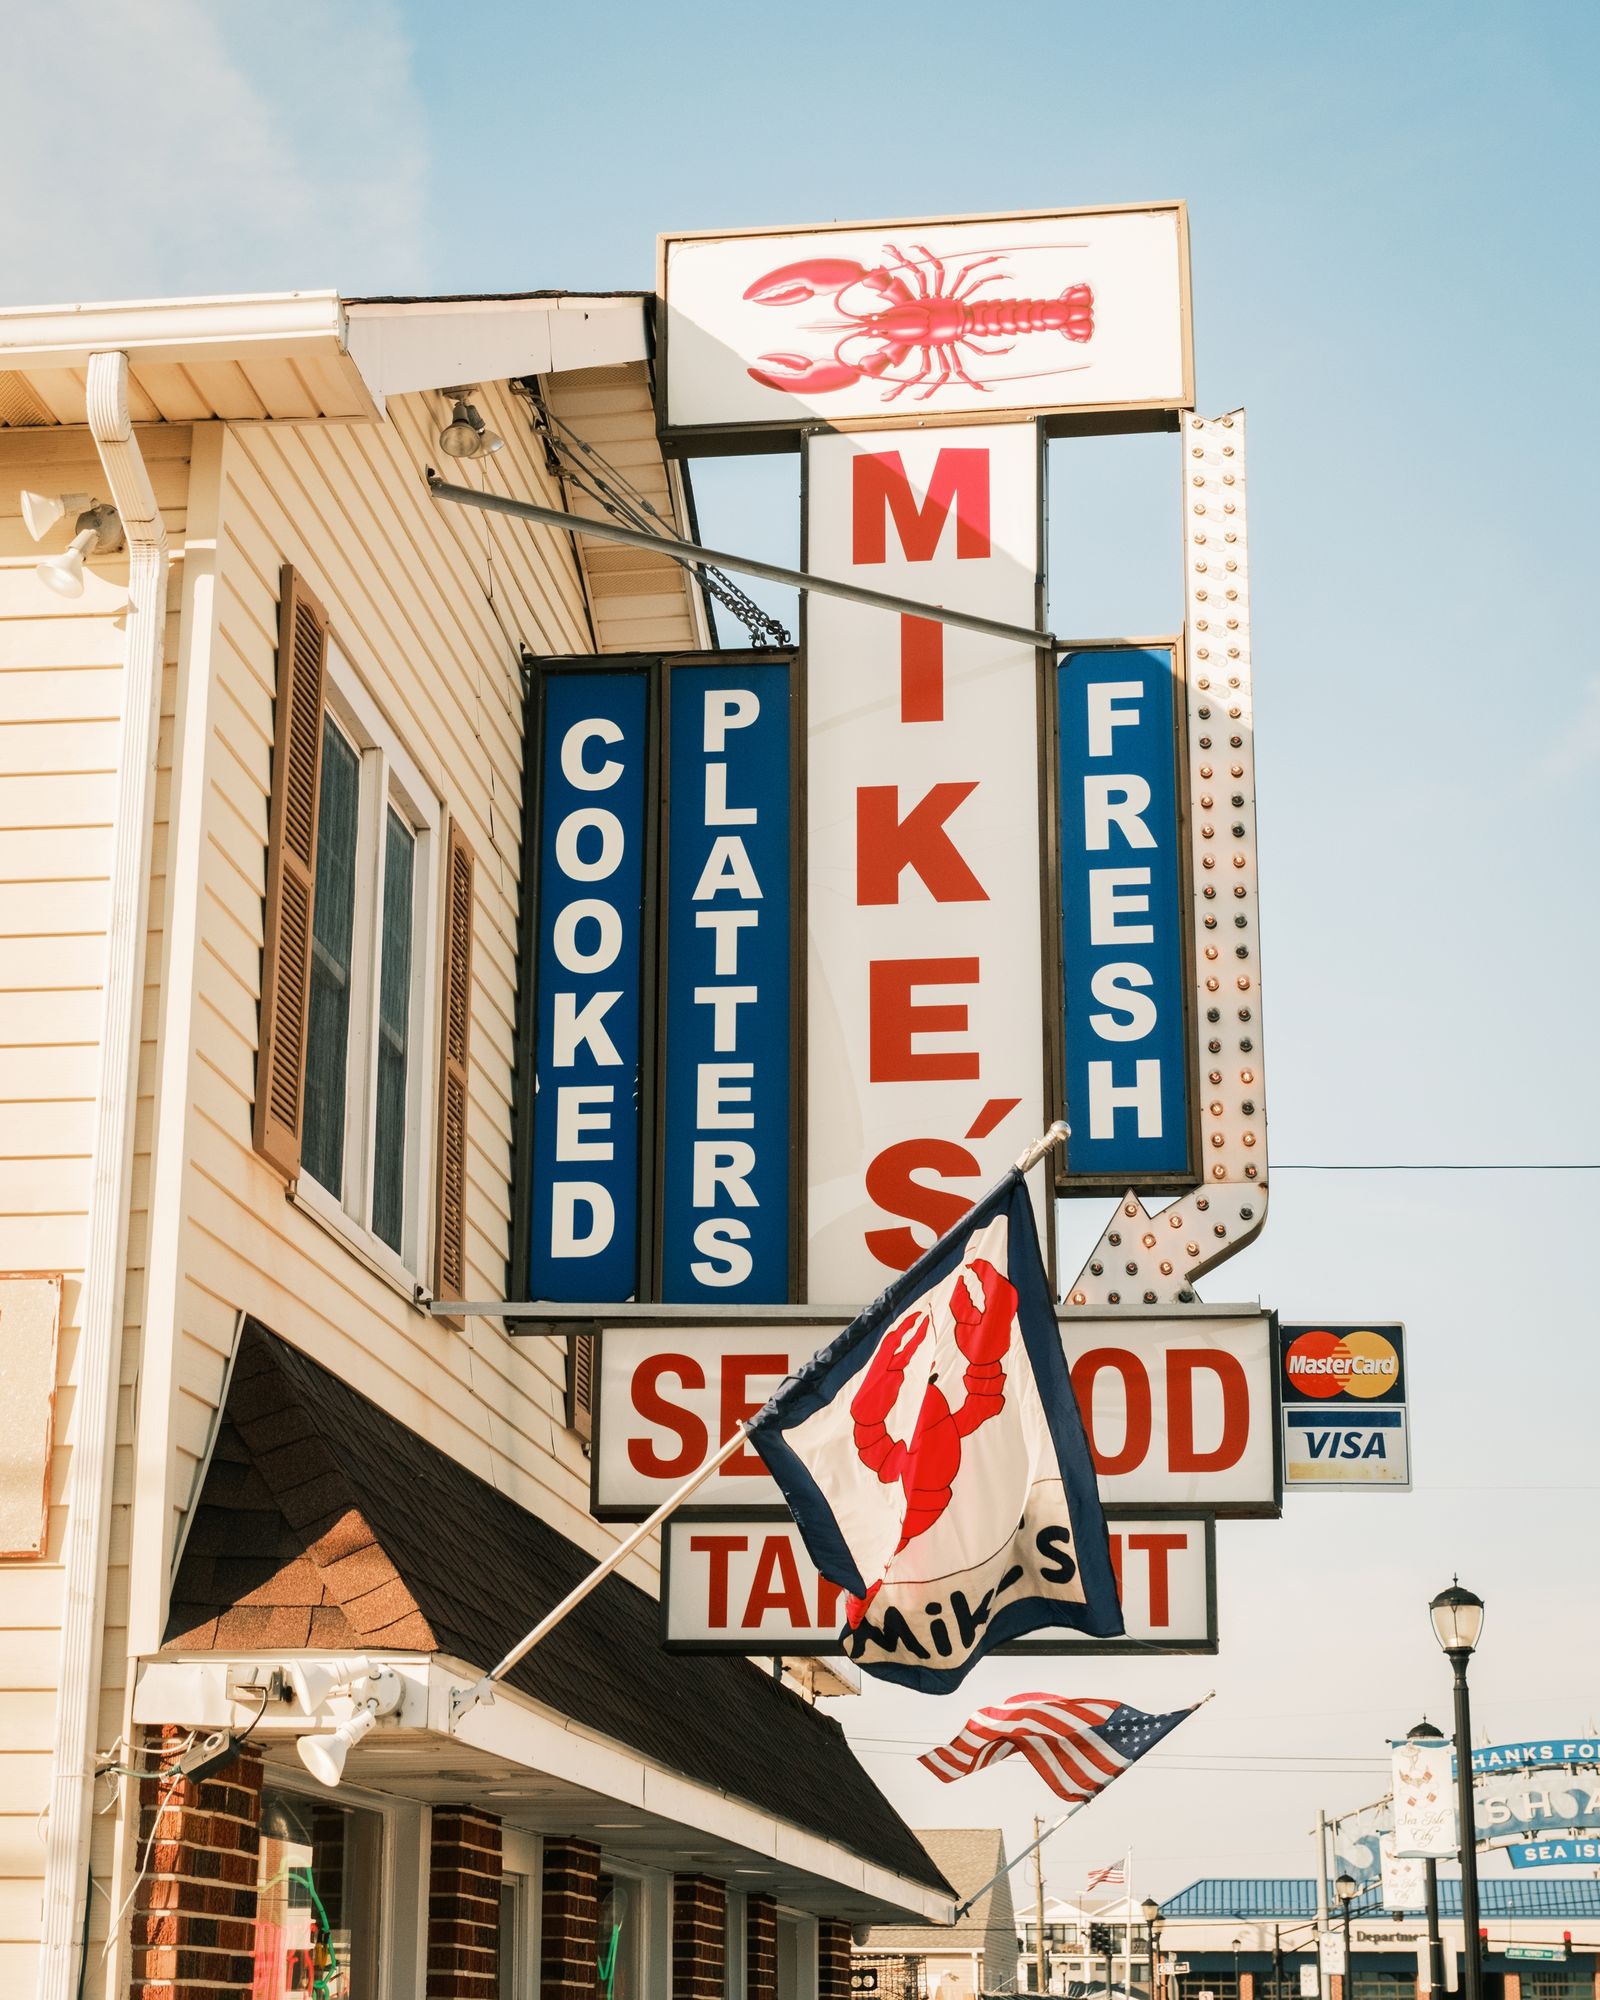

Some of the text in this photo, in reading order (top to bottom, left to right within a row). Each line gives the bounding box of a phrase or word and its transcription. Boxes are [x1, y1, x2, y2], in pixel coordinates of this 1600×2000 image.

[1083, 680, 1164, 1140] FRESH
[550, 718, 625, 1259] COOKED
[690, 688, 764, 1288] PLATTERS
[1289, 1354, 1396, 1375] MasterCard
[627, 1346, 1250, 1479] SEOD
[1302, 1432, 1386, 1459] VISA
[1454, 1743, 1600, 1769] HANKS FO
[1524, 1845, 1567, 1861] SEA
